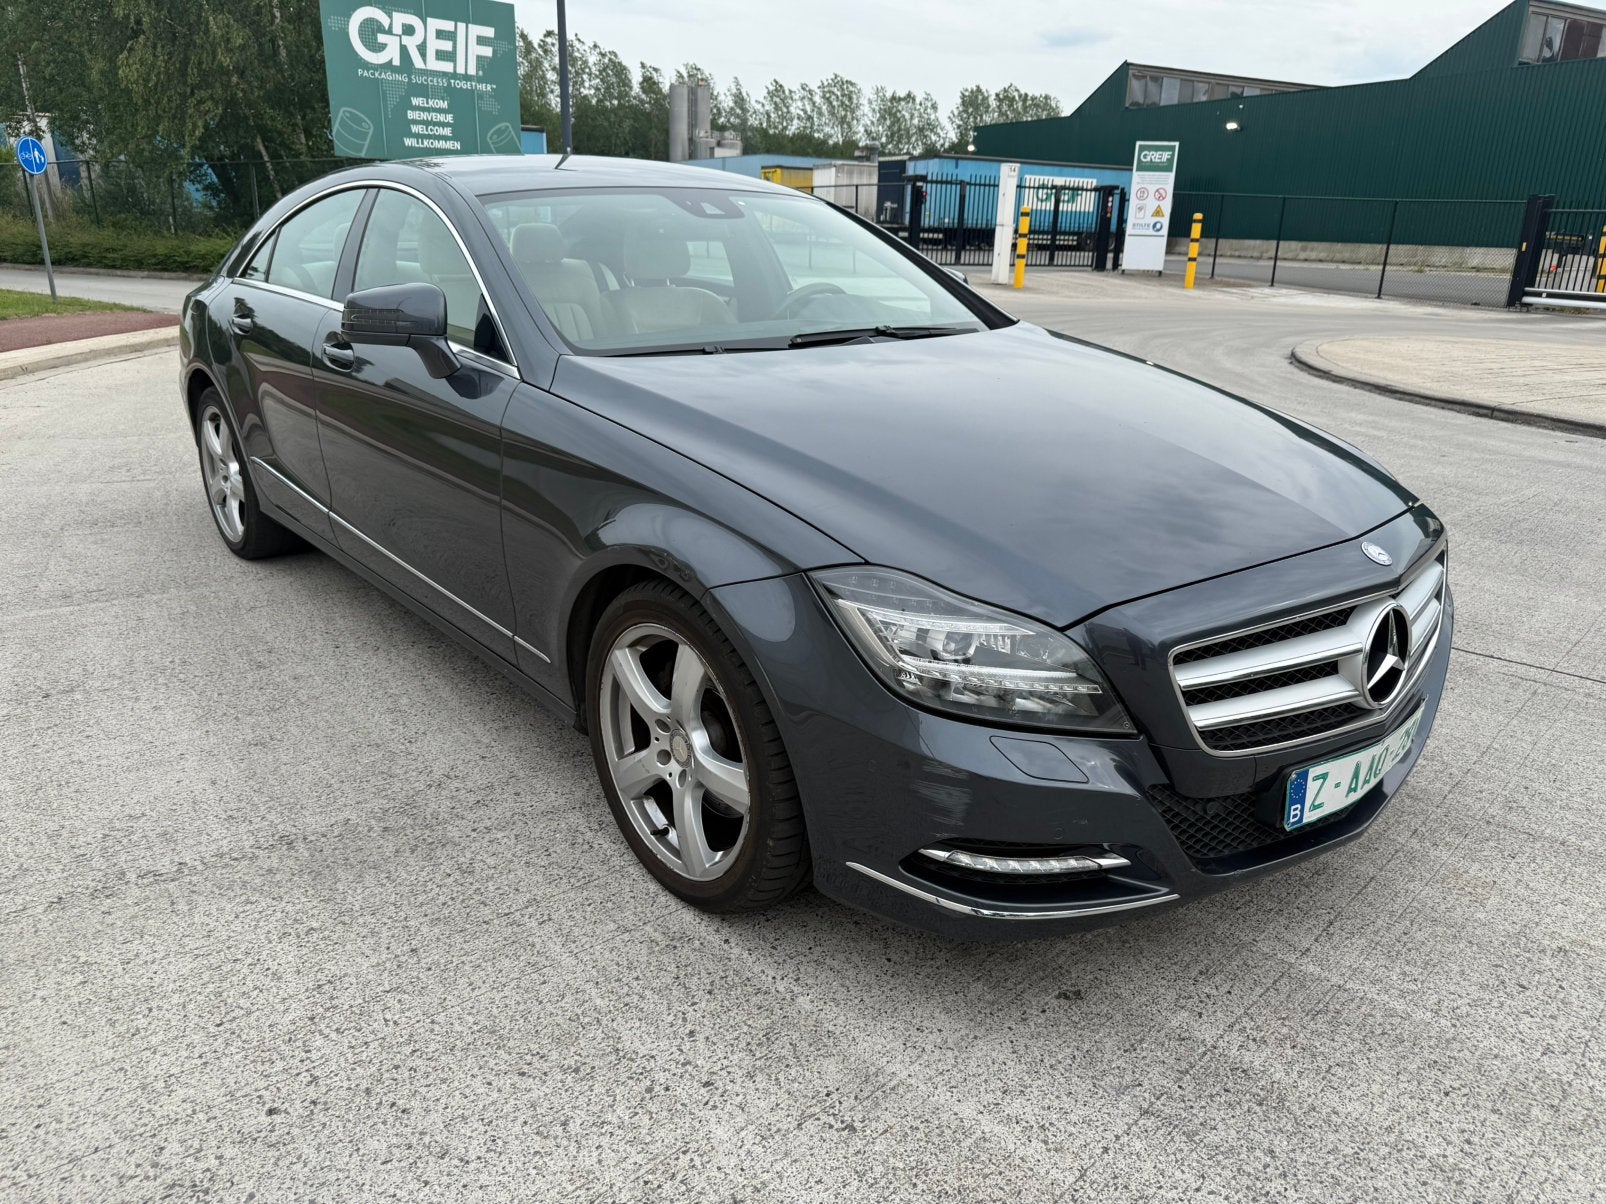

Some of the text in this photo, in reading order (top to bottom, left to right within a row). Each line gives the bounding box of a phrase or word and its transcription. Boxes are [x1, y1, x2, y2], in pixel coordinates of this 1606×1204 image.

[358, 69, 408, 82] PACKAGING
[411, 74, 448, 87] SUCCESS
[411, 96, 448, 110] WELKOM
[407, 110, 454, 123] BIENVENUE
[411, 123, 453, 137] WELCOME
[404, 137, 460, 150] WILLKOMMEN
[1140, 151, 1172, 162] GREIF
[1290, 804, 1301, 823] B
